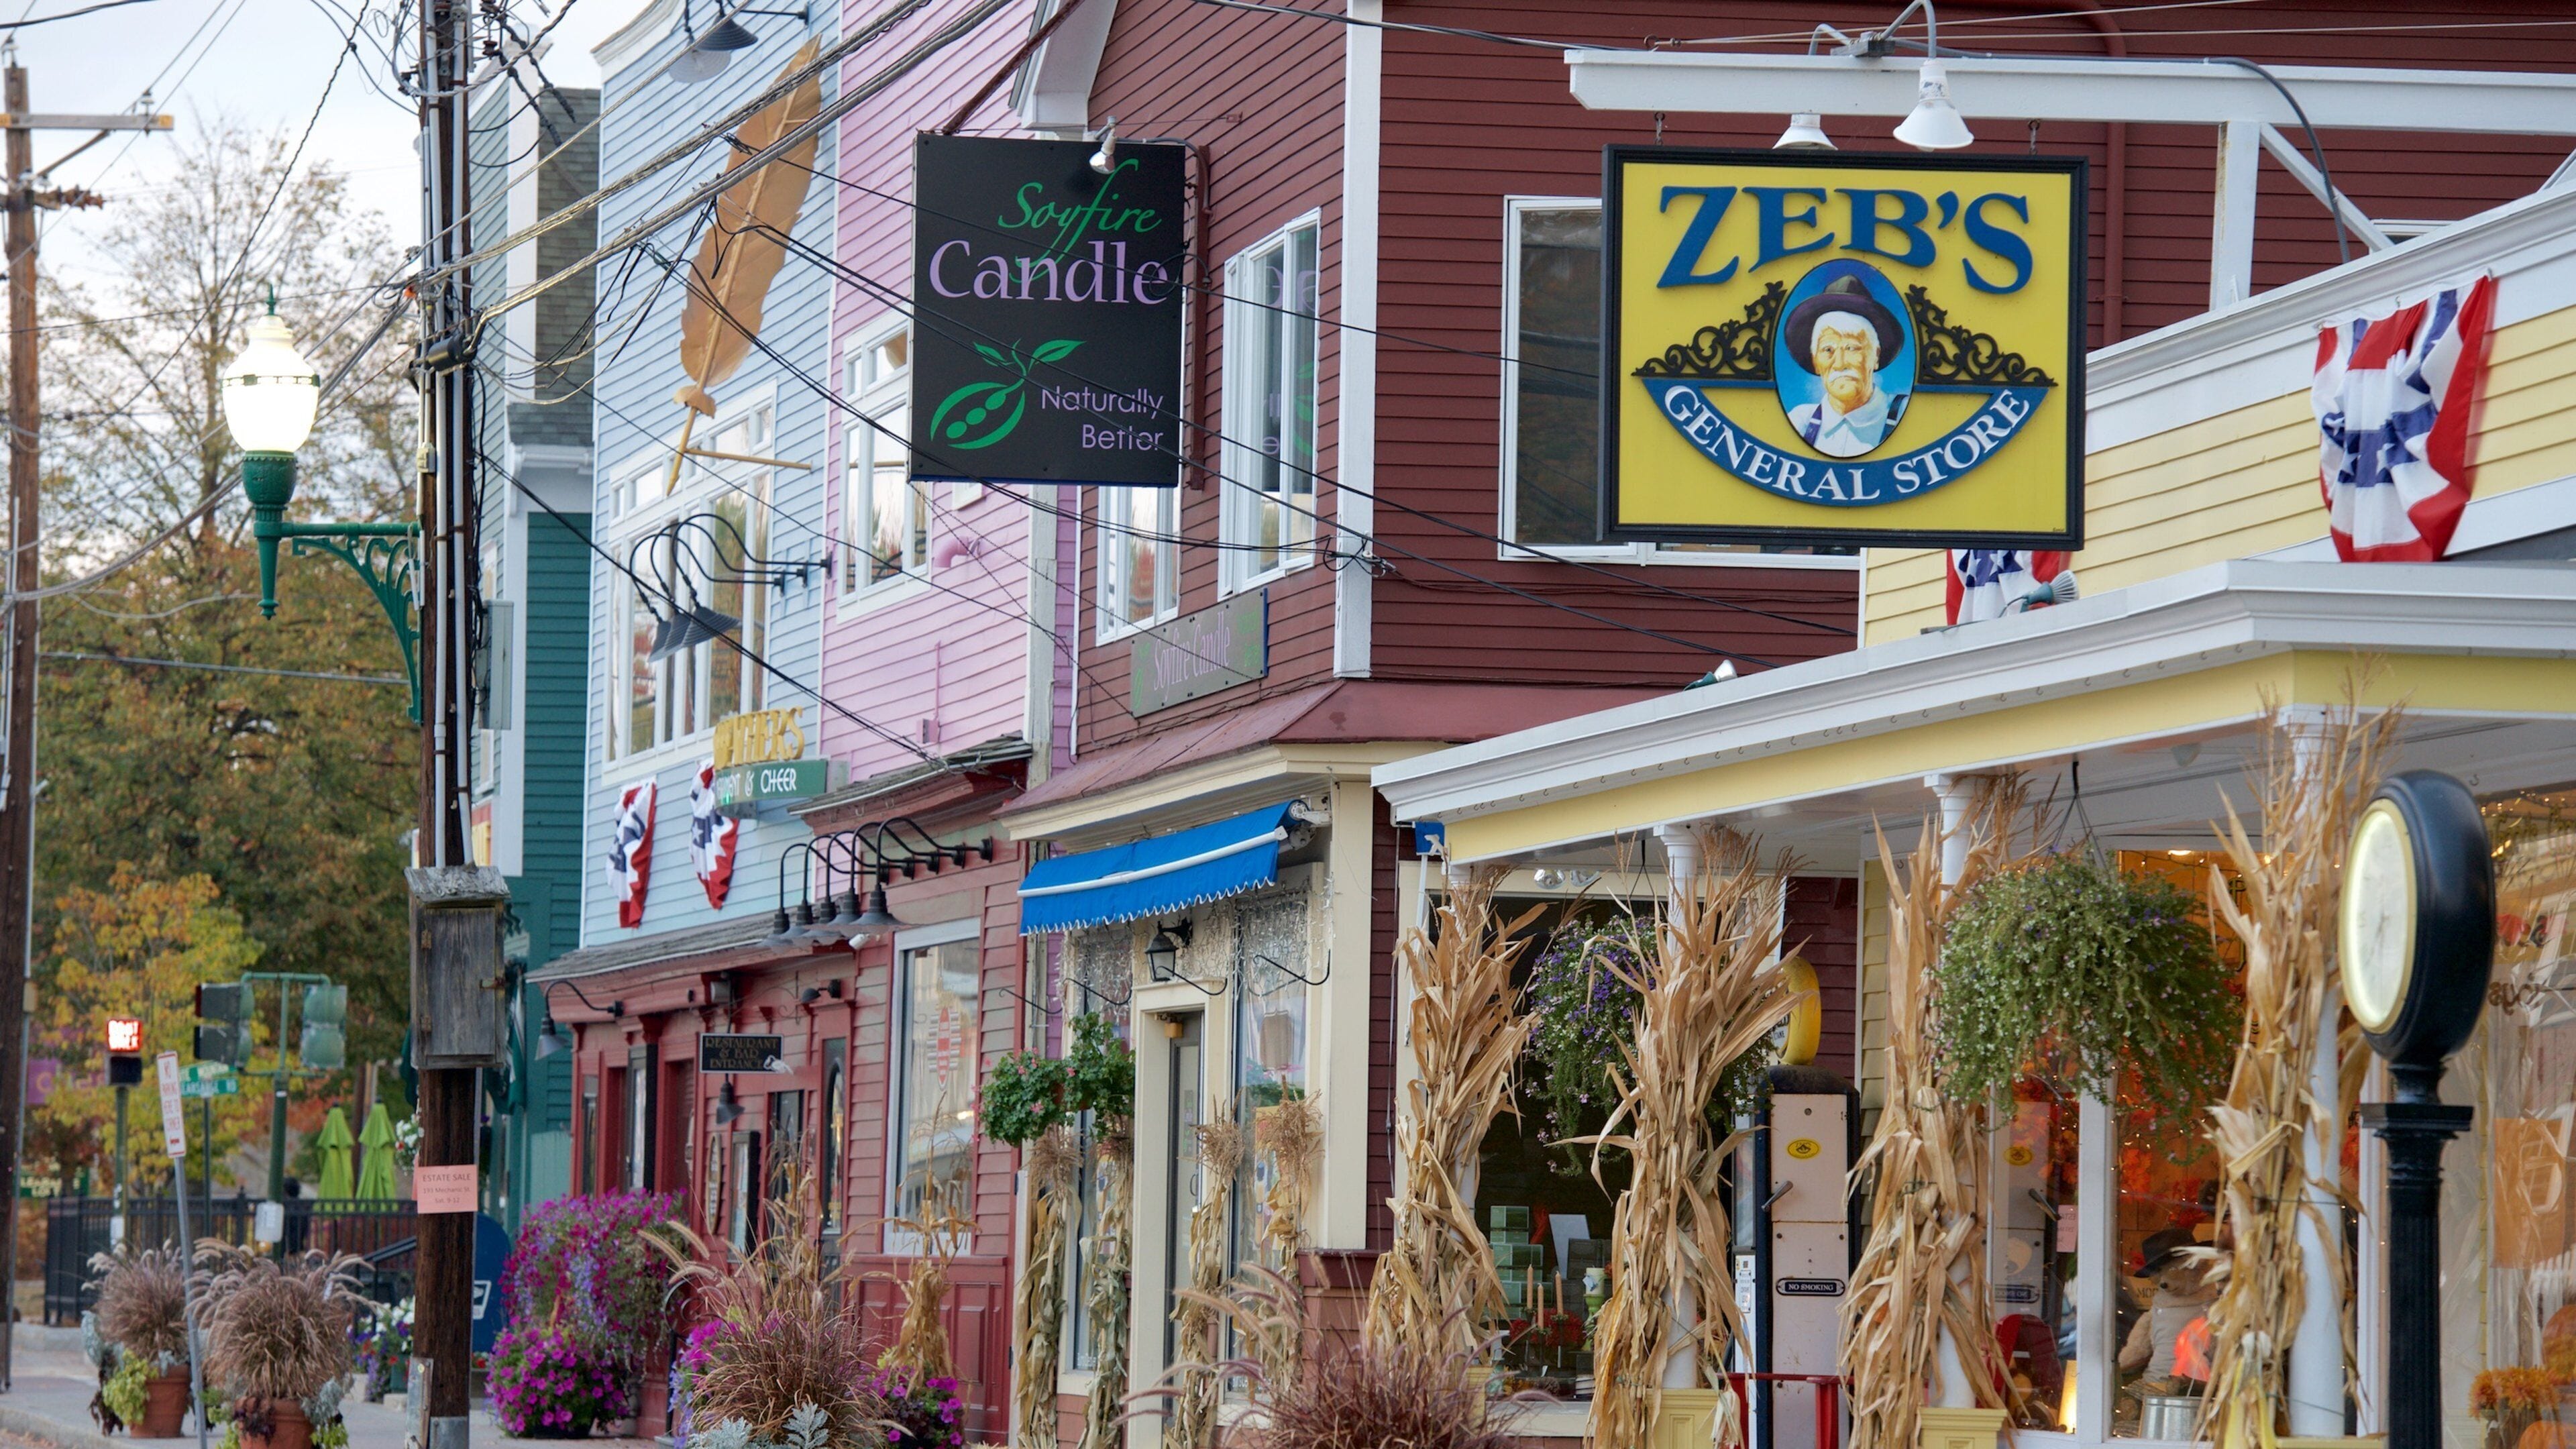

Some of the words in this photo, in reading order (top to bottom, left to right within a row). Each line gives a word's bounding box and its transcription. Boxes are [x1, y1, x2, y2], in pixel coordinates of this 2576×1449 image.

[998, 158, 1162, 284] Soyfire
[1657, 186, 2033, 294] ZEB'S
[929, 239, 1168, 305] Candle
[1041, 386, 1165, 419] Naturally
[1082, 424, 1164, 451] Better
[1664, 385, 1880, 501] GENERAL
[1894, 388, 2030, 494] STORE
[1154, 627, 1190, 702] Soyfire
[1193, 611, 1230, 678] Candle
[760, 768, 797, 794] CHEER
[706, 1037, 778, 1049] RESTAURANT
[719, 1049, 729, 1059] &
[735, 1049, 759, 1059] BAR
[710, 1059, 763, 1069] ENTRANCE
[423, 1174, 451, 1182] ESTATE
[452, 1173, 472, 1181] SALE
